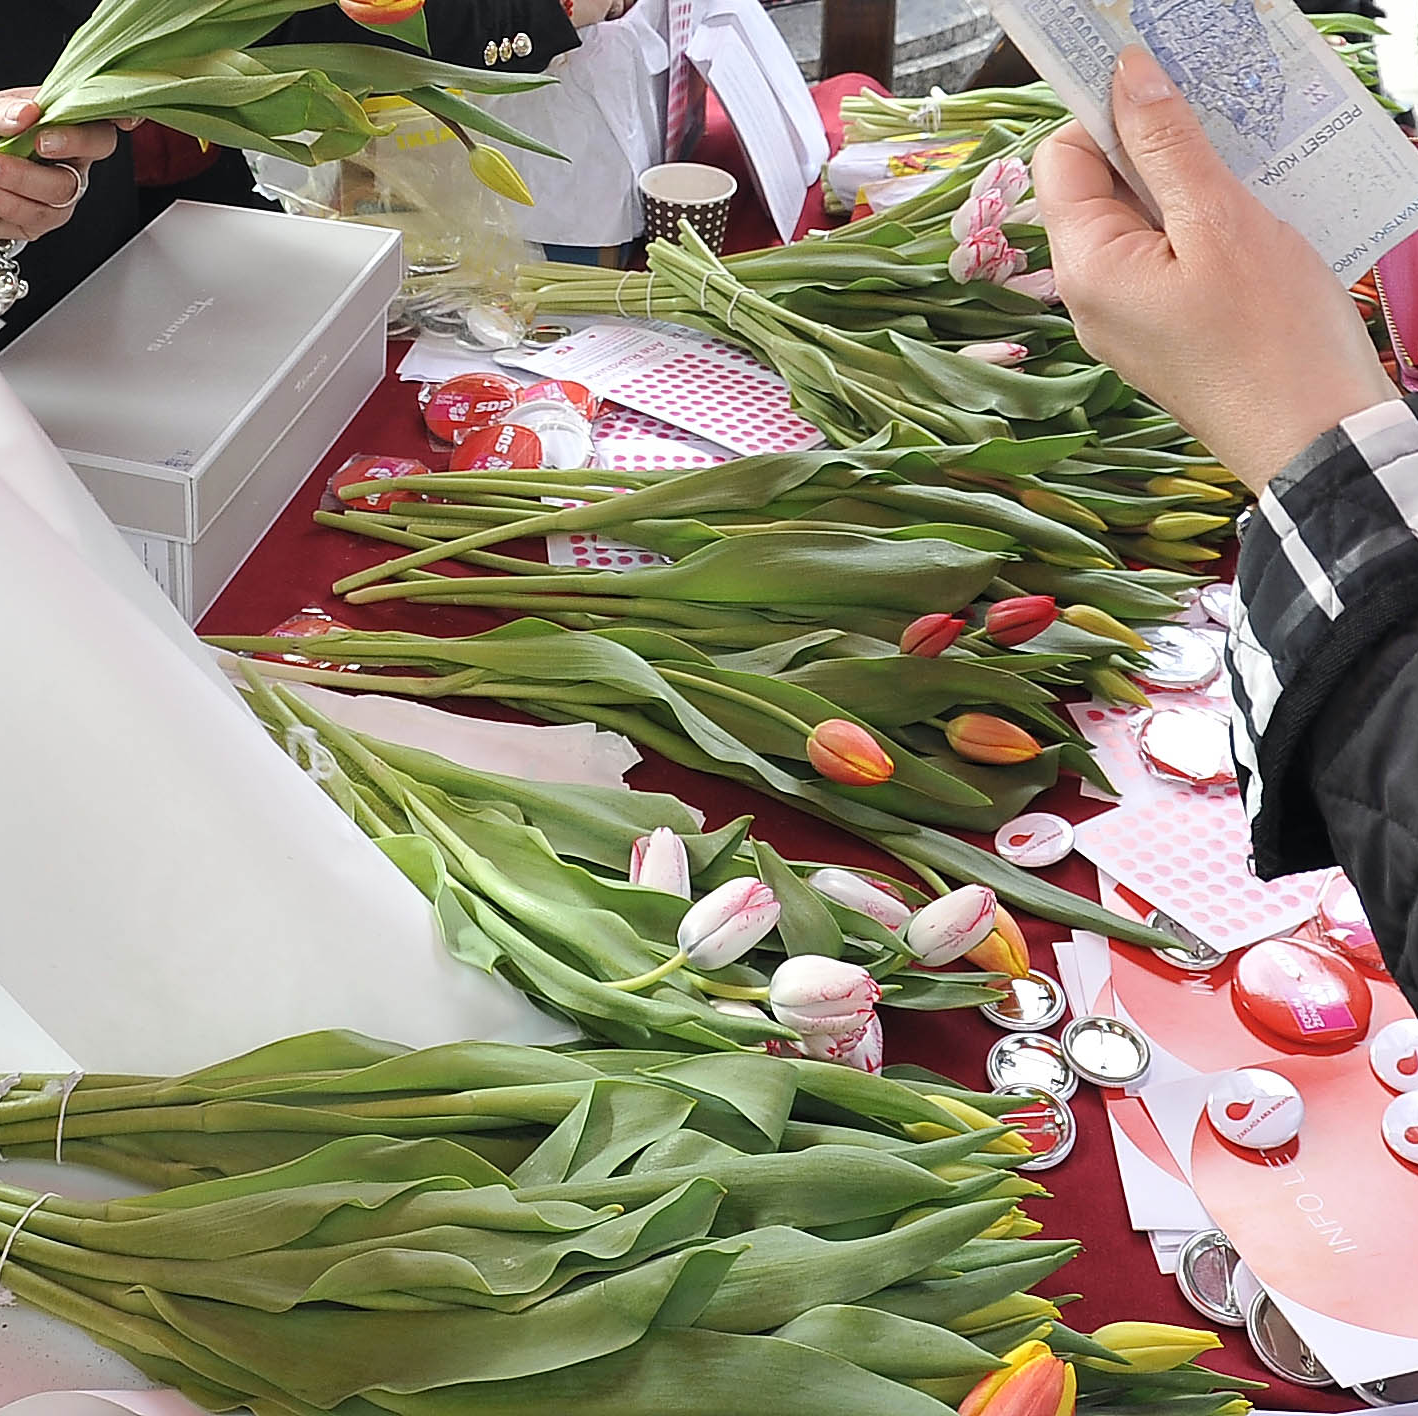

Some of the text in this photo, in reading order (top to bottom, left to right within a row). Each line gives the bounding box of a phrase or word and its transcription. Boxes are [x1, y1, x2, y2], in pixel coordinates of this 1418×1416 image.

[1300, 103, 1364, 159] PEDESET
[1260, 152, 1301, 187] KUNA
[1332, 242, 1370, 274] NARO
[474, 400, 512, 413] SDP
[495, 425, 516, 454] SDP
[1187, 971, 1216, 997] IN
[1295, 1193, 1358, 1254] INFO
